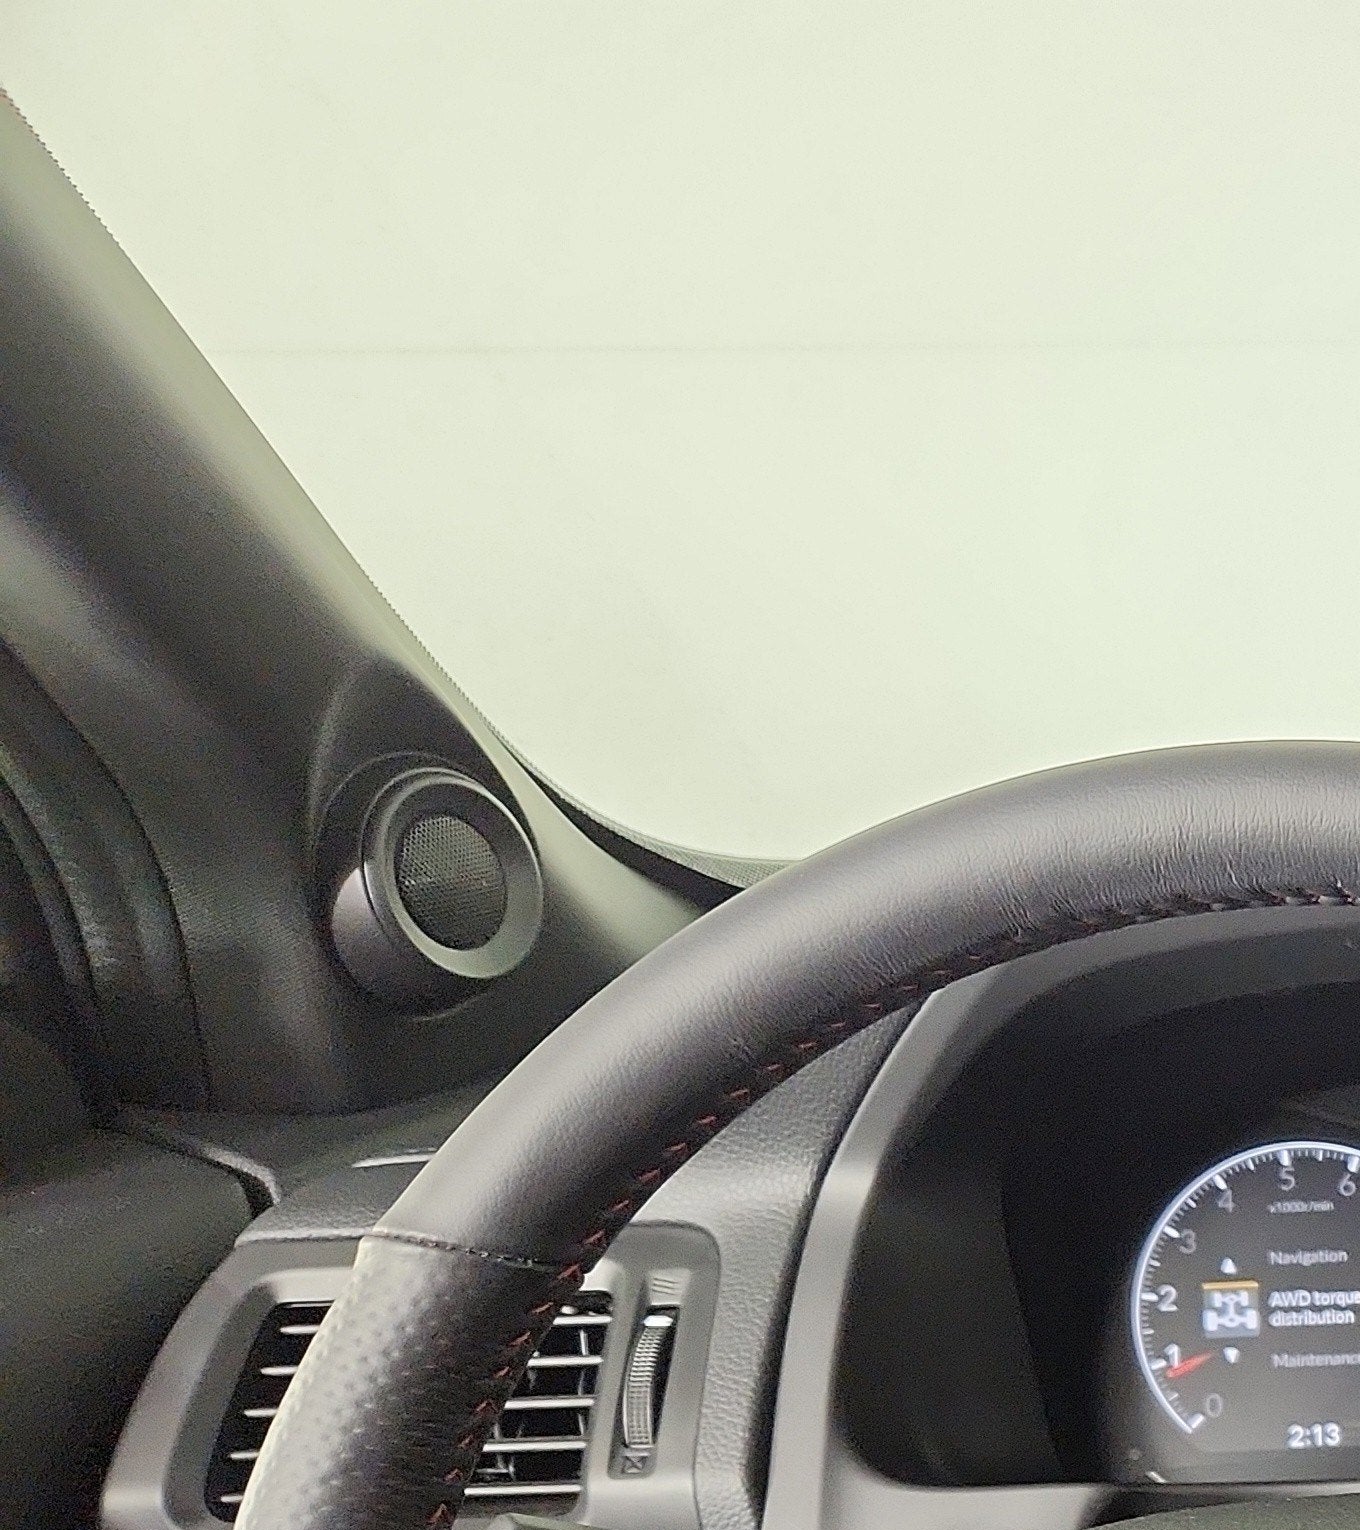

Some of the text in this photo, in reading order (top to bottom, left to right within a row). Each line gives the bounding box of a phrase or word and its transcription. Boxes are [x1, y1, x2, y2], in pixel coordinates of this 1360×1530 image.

[1279, 1167, 1296, 1190] 5
[1339, 1173, 1357, 1197] 6
[1218, 1190, 1235, 1213] 4
[1179, 1231, 1198, 1254] 3
[1268, 1249, 1348, 1266] Navigation
[1157, 1286, 1178, 1311] 2
[1268, 1289, 1309, 1308] AWD
[1268, 1307, 1356, 1326] distribution
[1166, 1345, 1180, 1367] 1
[1205, 1395, 1224, 1418] 0
[1287, 1422, 1342, 1448] 2:13
